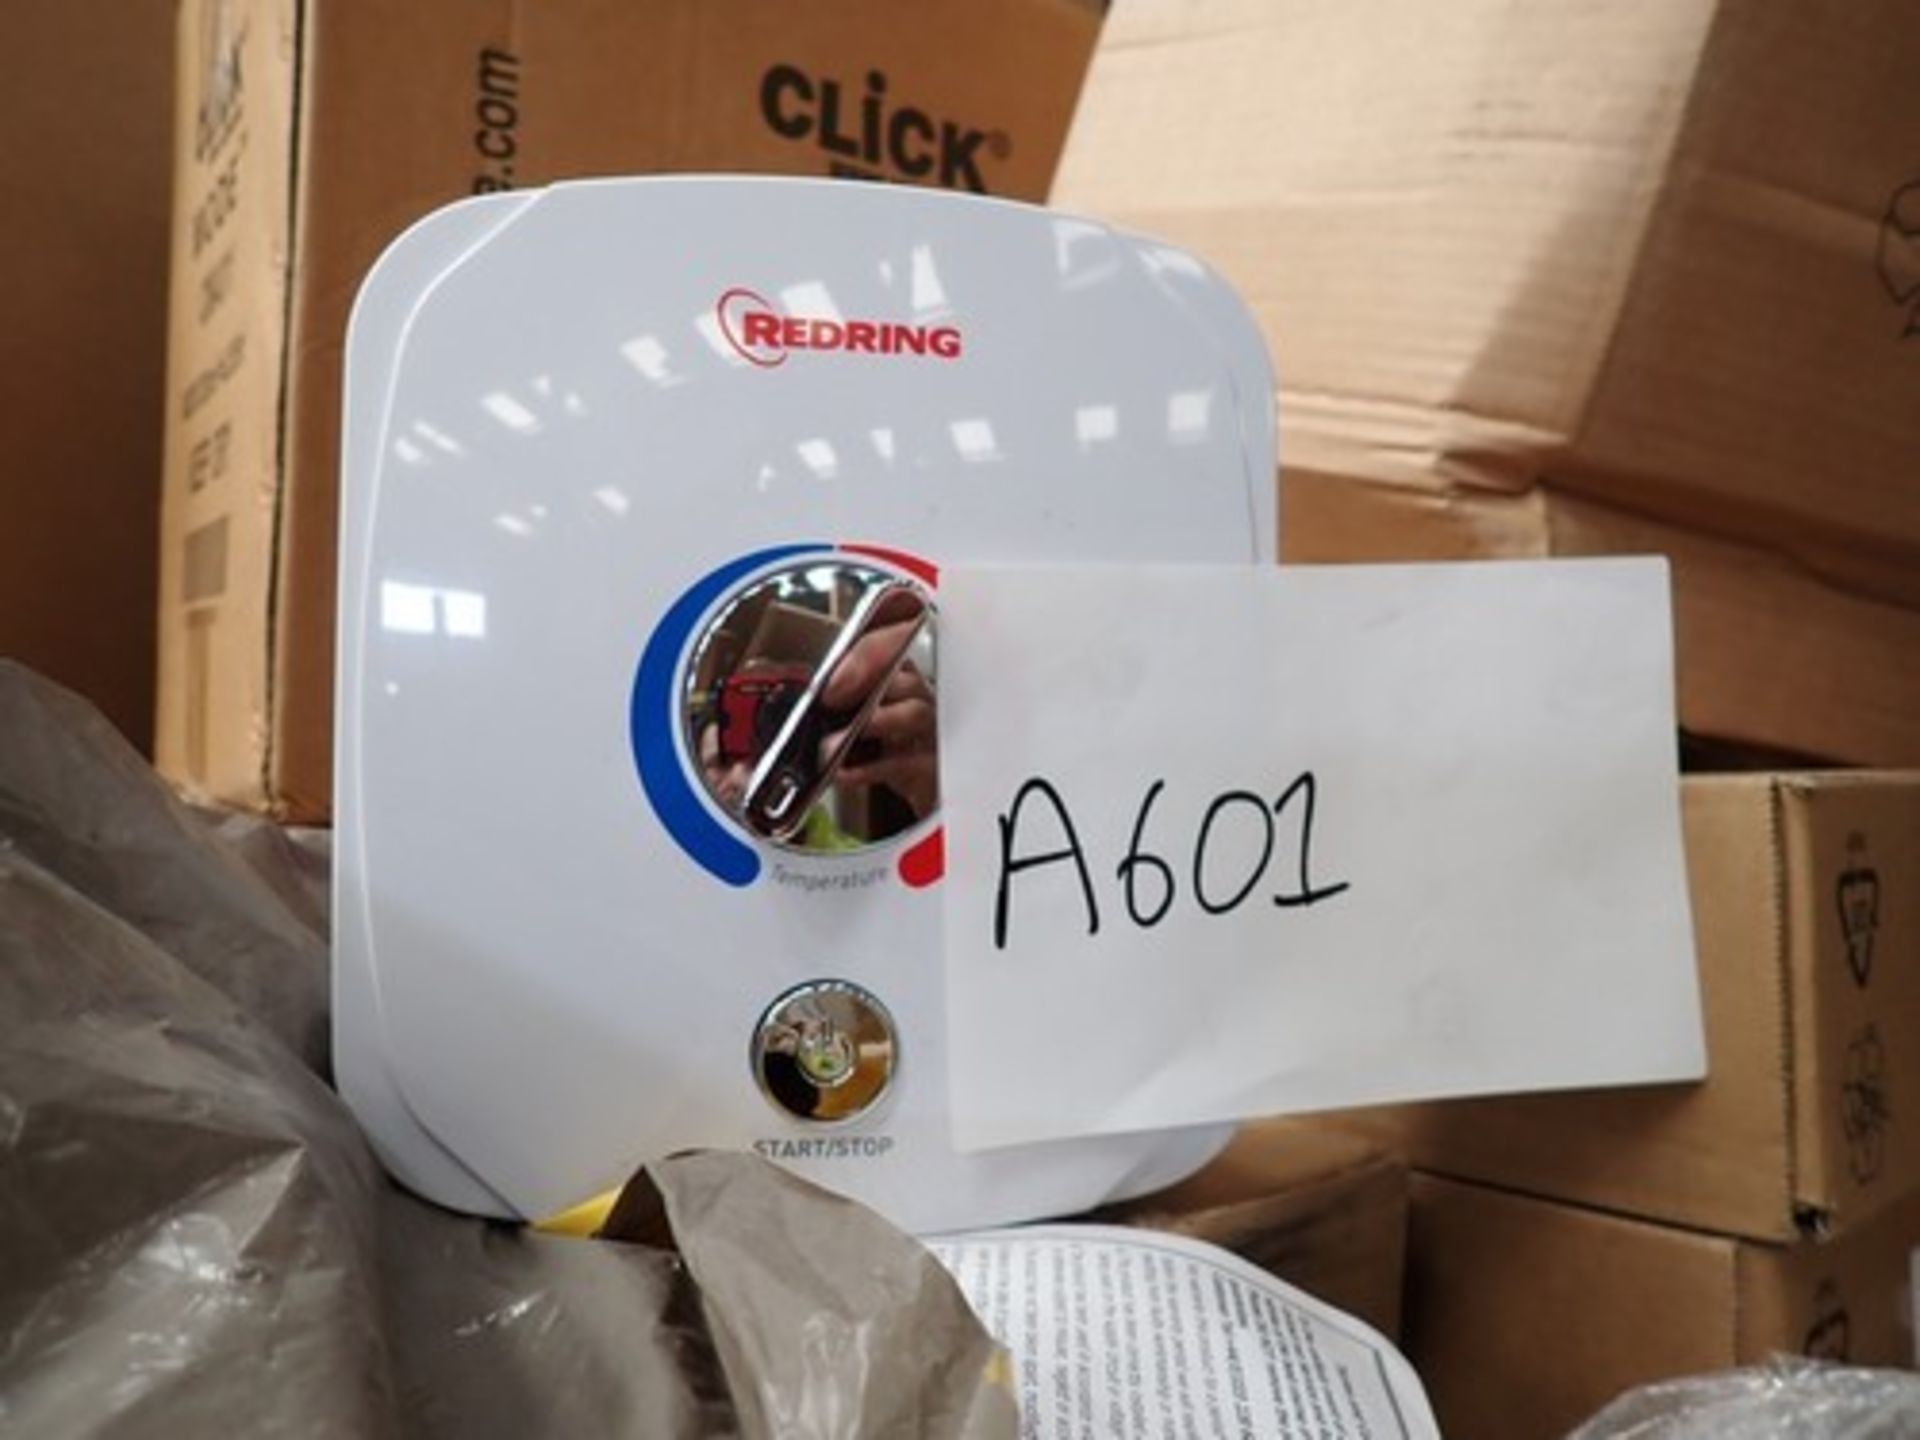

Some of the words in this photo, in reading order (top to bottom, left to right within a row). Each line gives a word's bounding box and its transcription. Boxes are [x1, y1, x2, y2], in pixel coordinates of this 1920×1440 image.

[743, 310, 961, 359] REDRING
[768, 862, 889, 890] Temperature
[994, 770, 1350, 950] A601
[752, 1135, 895, 1158] START/STOP
